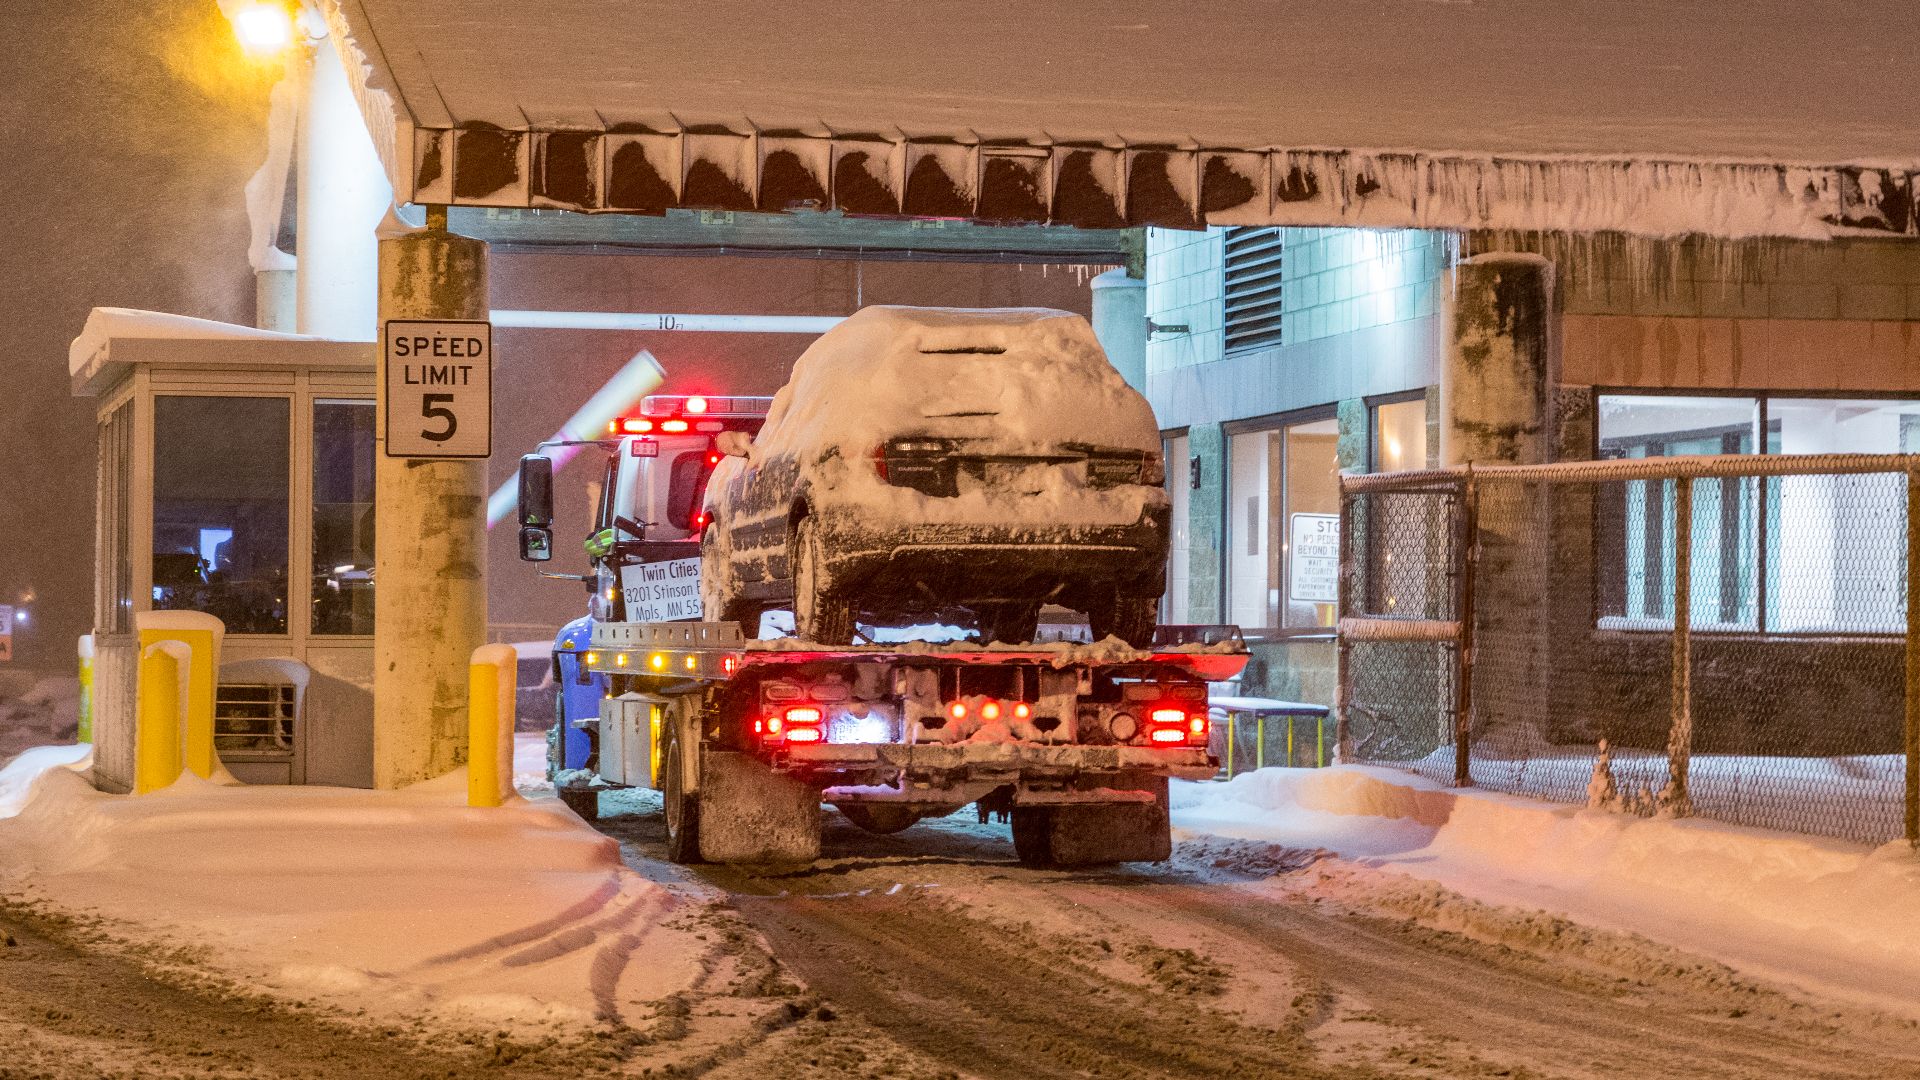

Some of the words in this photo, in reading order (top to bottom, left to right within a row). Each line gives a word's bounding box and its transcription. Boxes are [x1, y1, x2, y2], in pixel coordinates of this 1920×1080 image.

[658, 315, 675, 330] 10
[395, 336, 483, 357] SPEED
[404, 365, 473, 385] LIMIT
[421, 393, 458, 442] 5
[1297, 545, 1328, 556] BEYOND
[640, 564, 666, 582] Twin
[669, 561, 699, 579] Cities
[625, 586, 651, 603] 3201
[653, 584, 693, 600] Stinson
[636, 603, 664, 622] Mpls,
[667, 601, 683, 617] MN
[686, 599, 703, 615] 55
